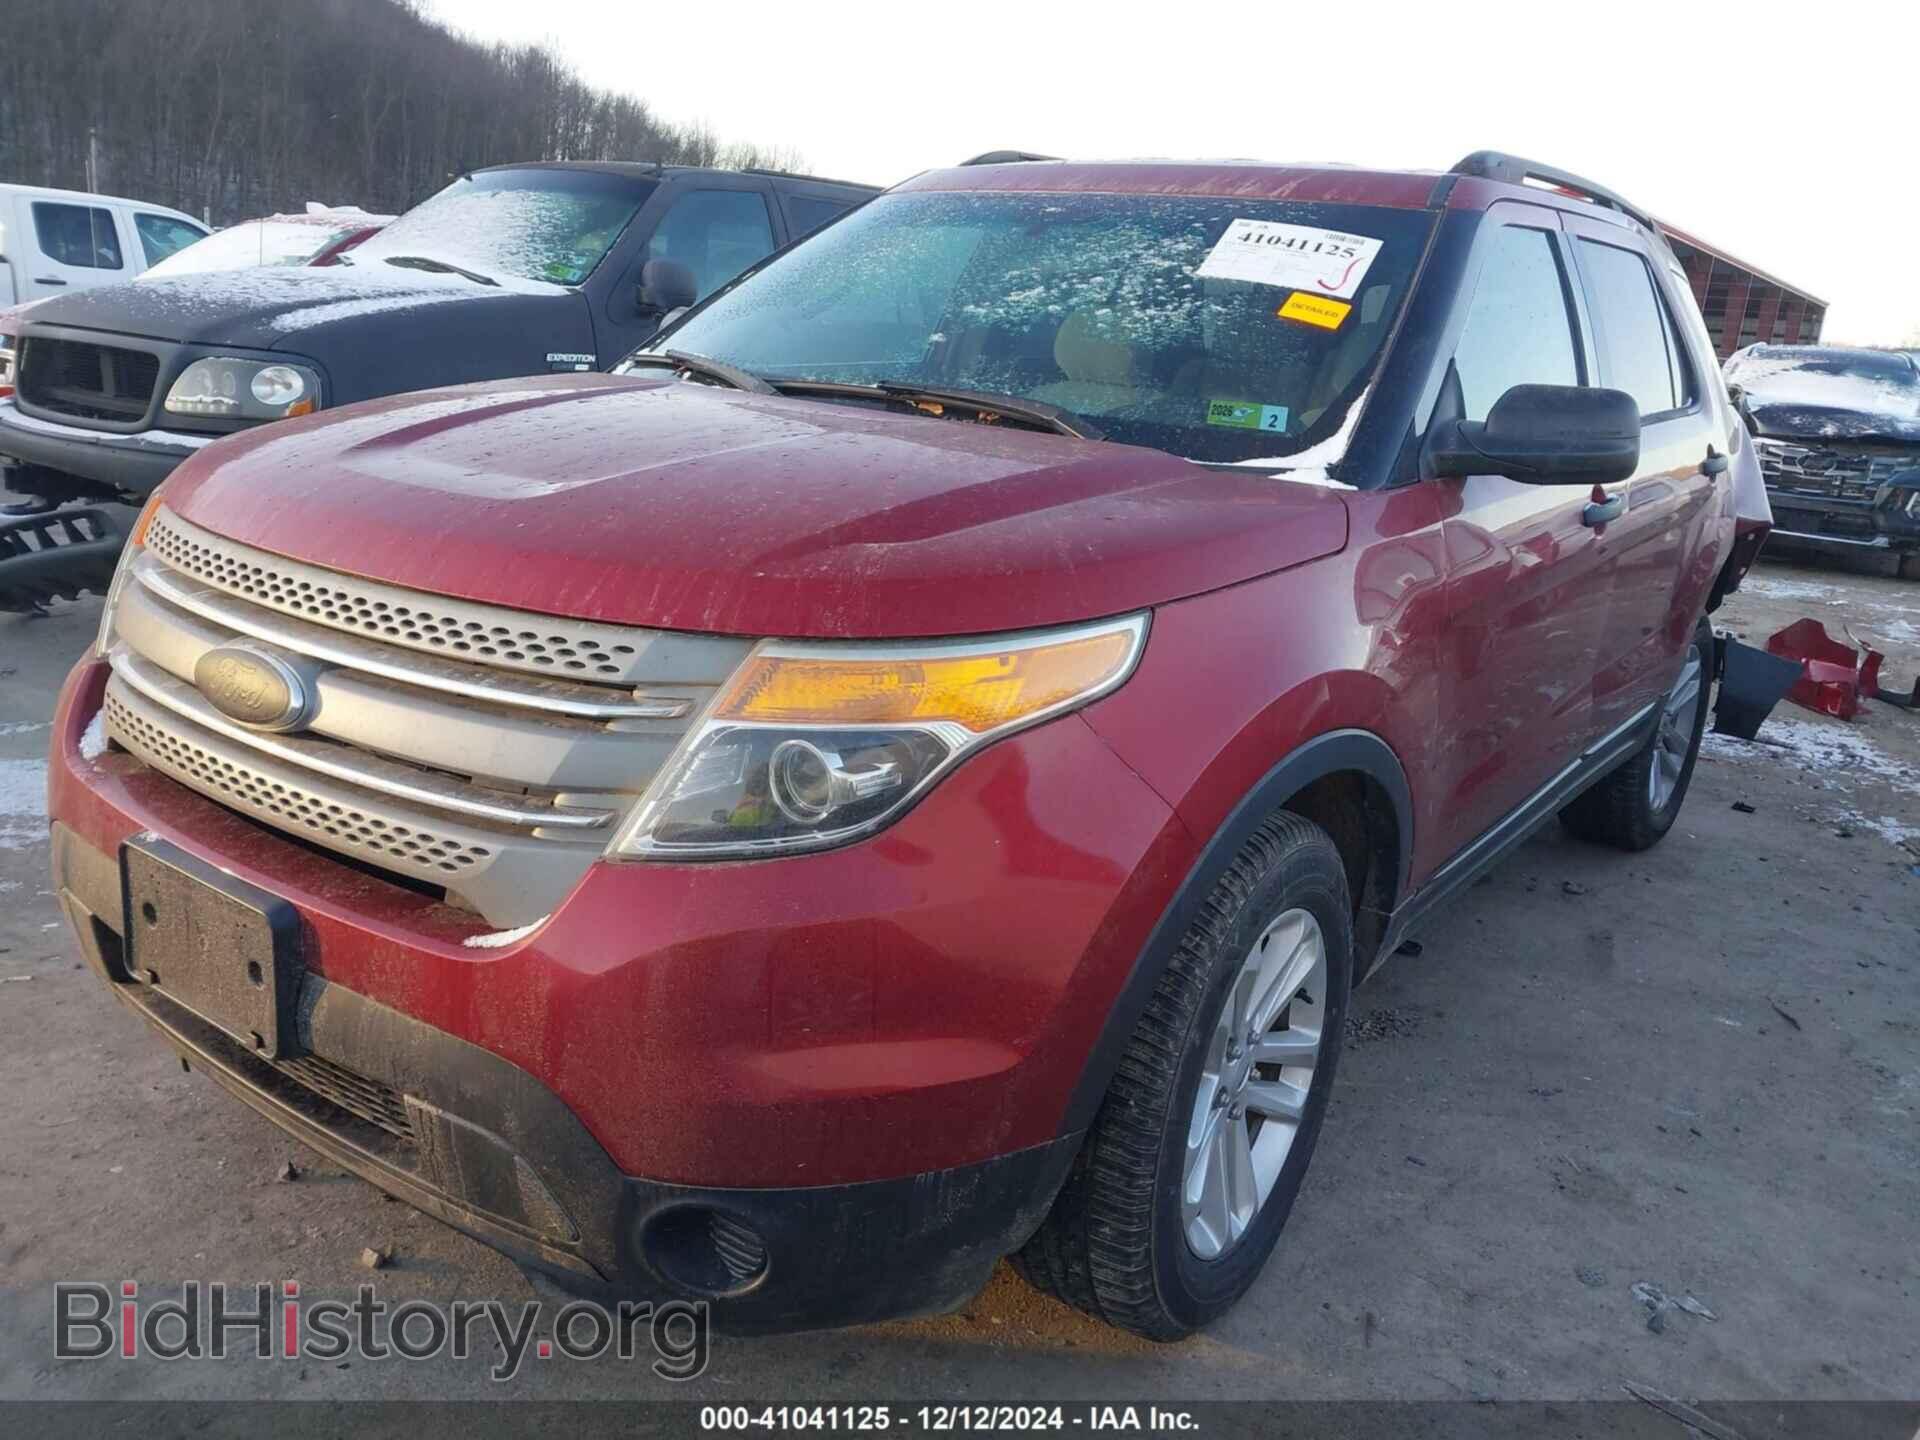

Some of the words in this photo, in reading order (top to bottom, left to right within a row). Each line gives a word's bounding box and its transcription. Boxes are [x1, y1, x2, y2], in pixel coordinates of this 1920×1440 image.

[1237, 231, 1358, 259] 41041125
[1291, 301, 1339, 318] DETAILED
[546, 353, 596, 363] EXPEDITION
[1268, 414, 1279, 428] 2
